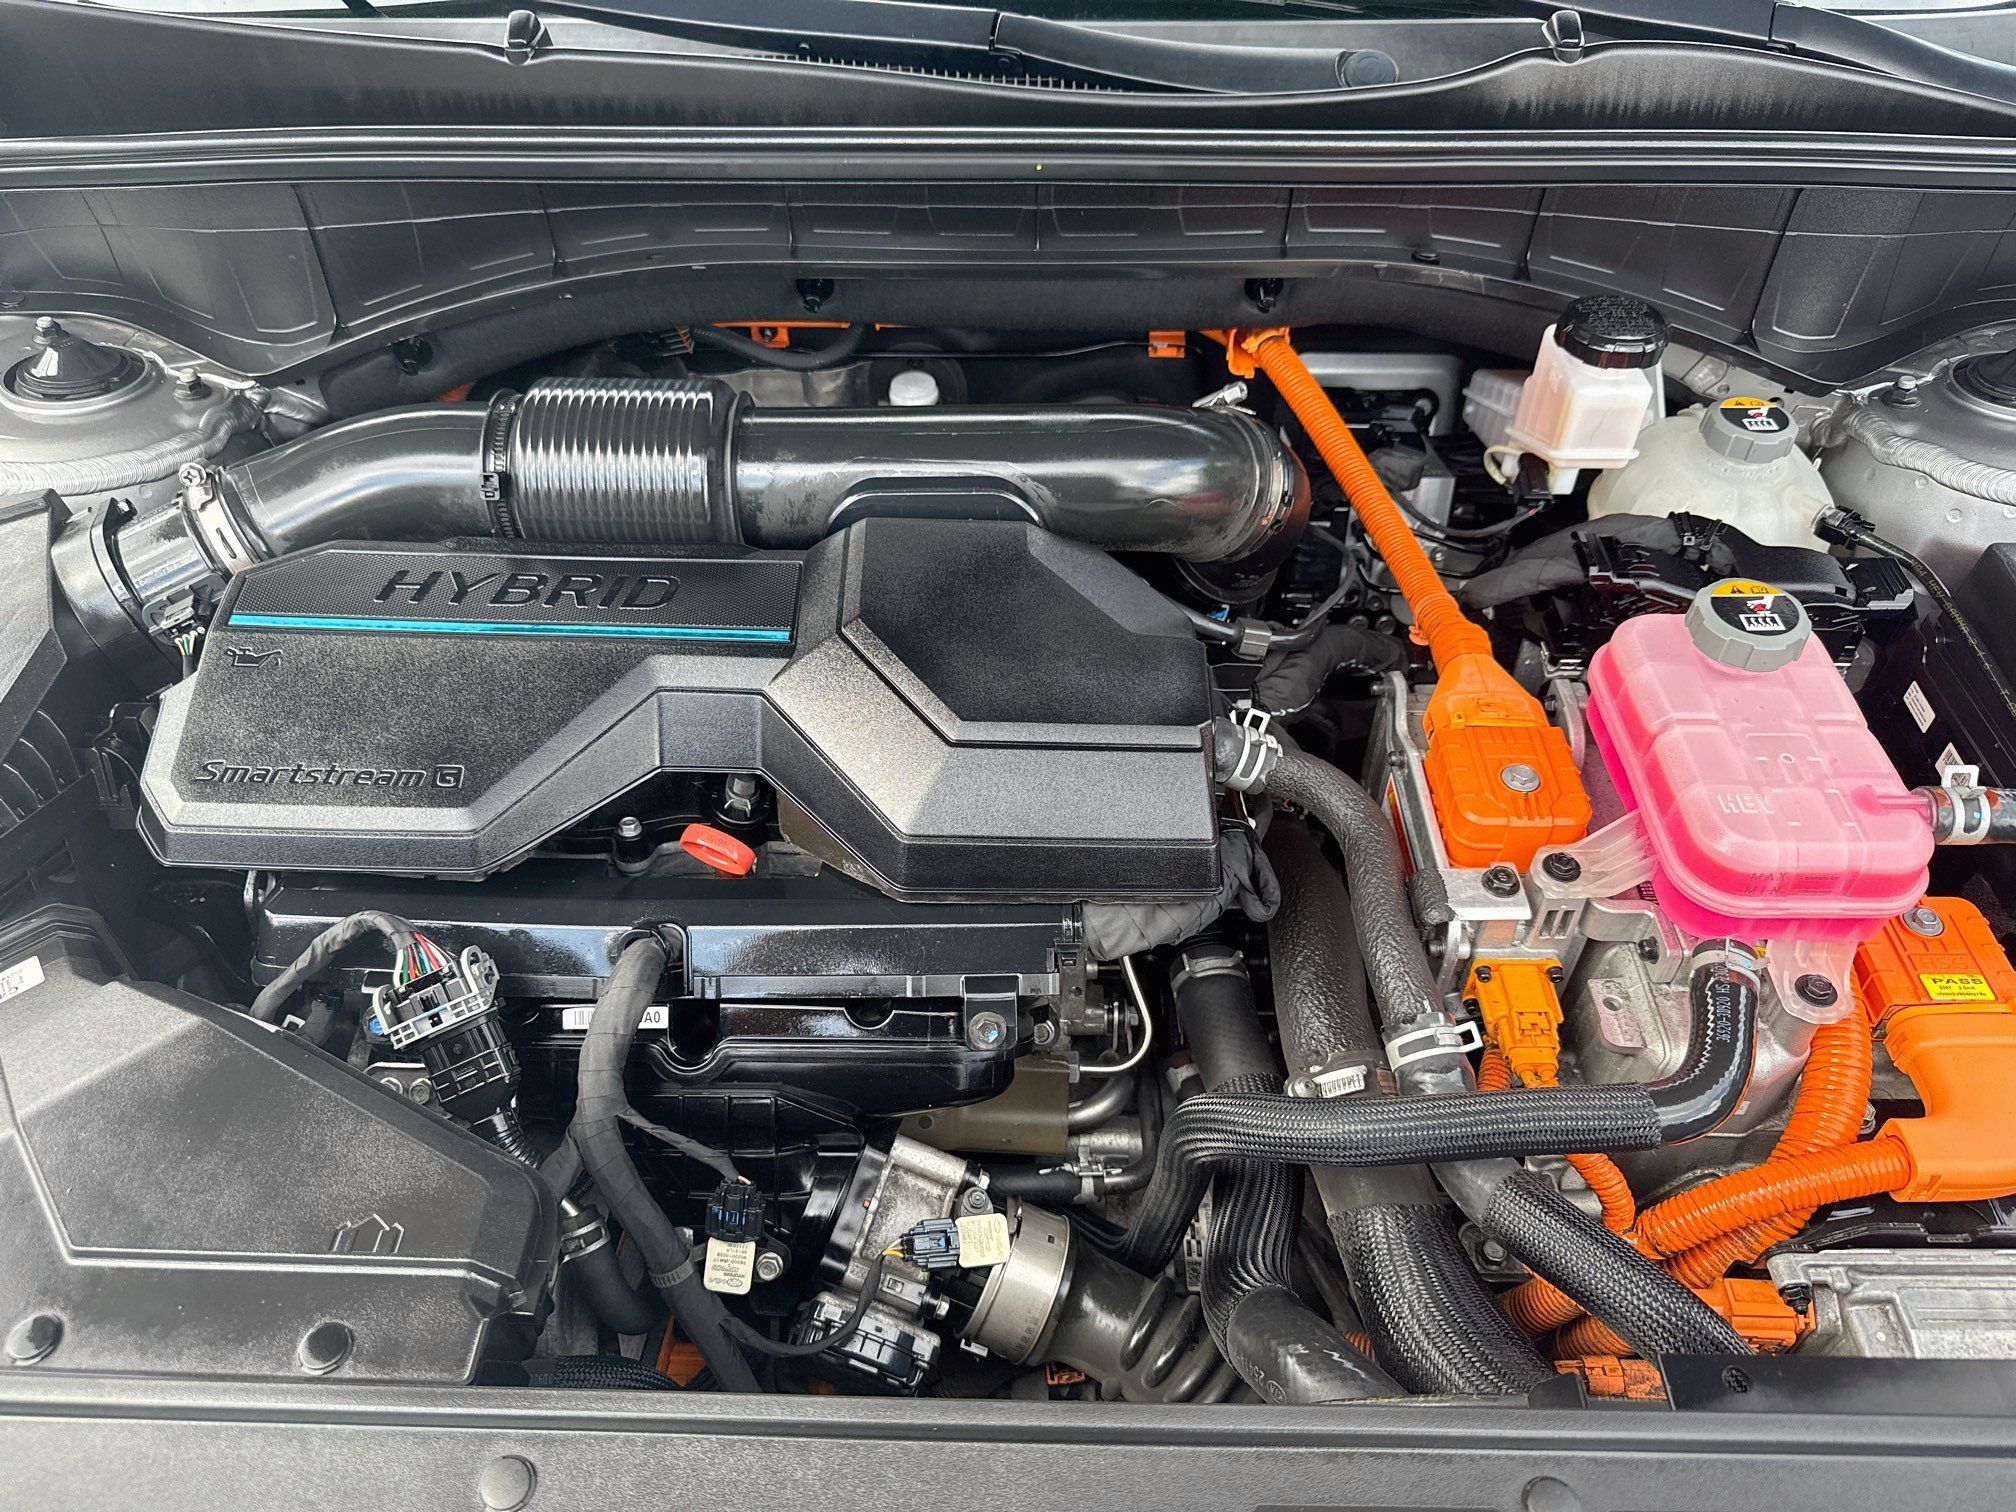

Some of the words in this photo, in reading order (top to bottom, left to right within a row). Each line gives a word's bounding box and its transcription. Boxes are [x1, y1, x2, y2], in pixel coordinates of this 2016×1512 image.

[373, 568, 682, 610] HYBRID
[195, 759, 427, 787] Smartstream
[435, 766, 464, 788] G
[1750, 872, 1788, 881] MAX
[1744, 886, 1782, 895] MIN
[1931, 977, 1984, 985] PASS
[641, 1011, 661, 1024] A0
